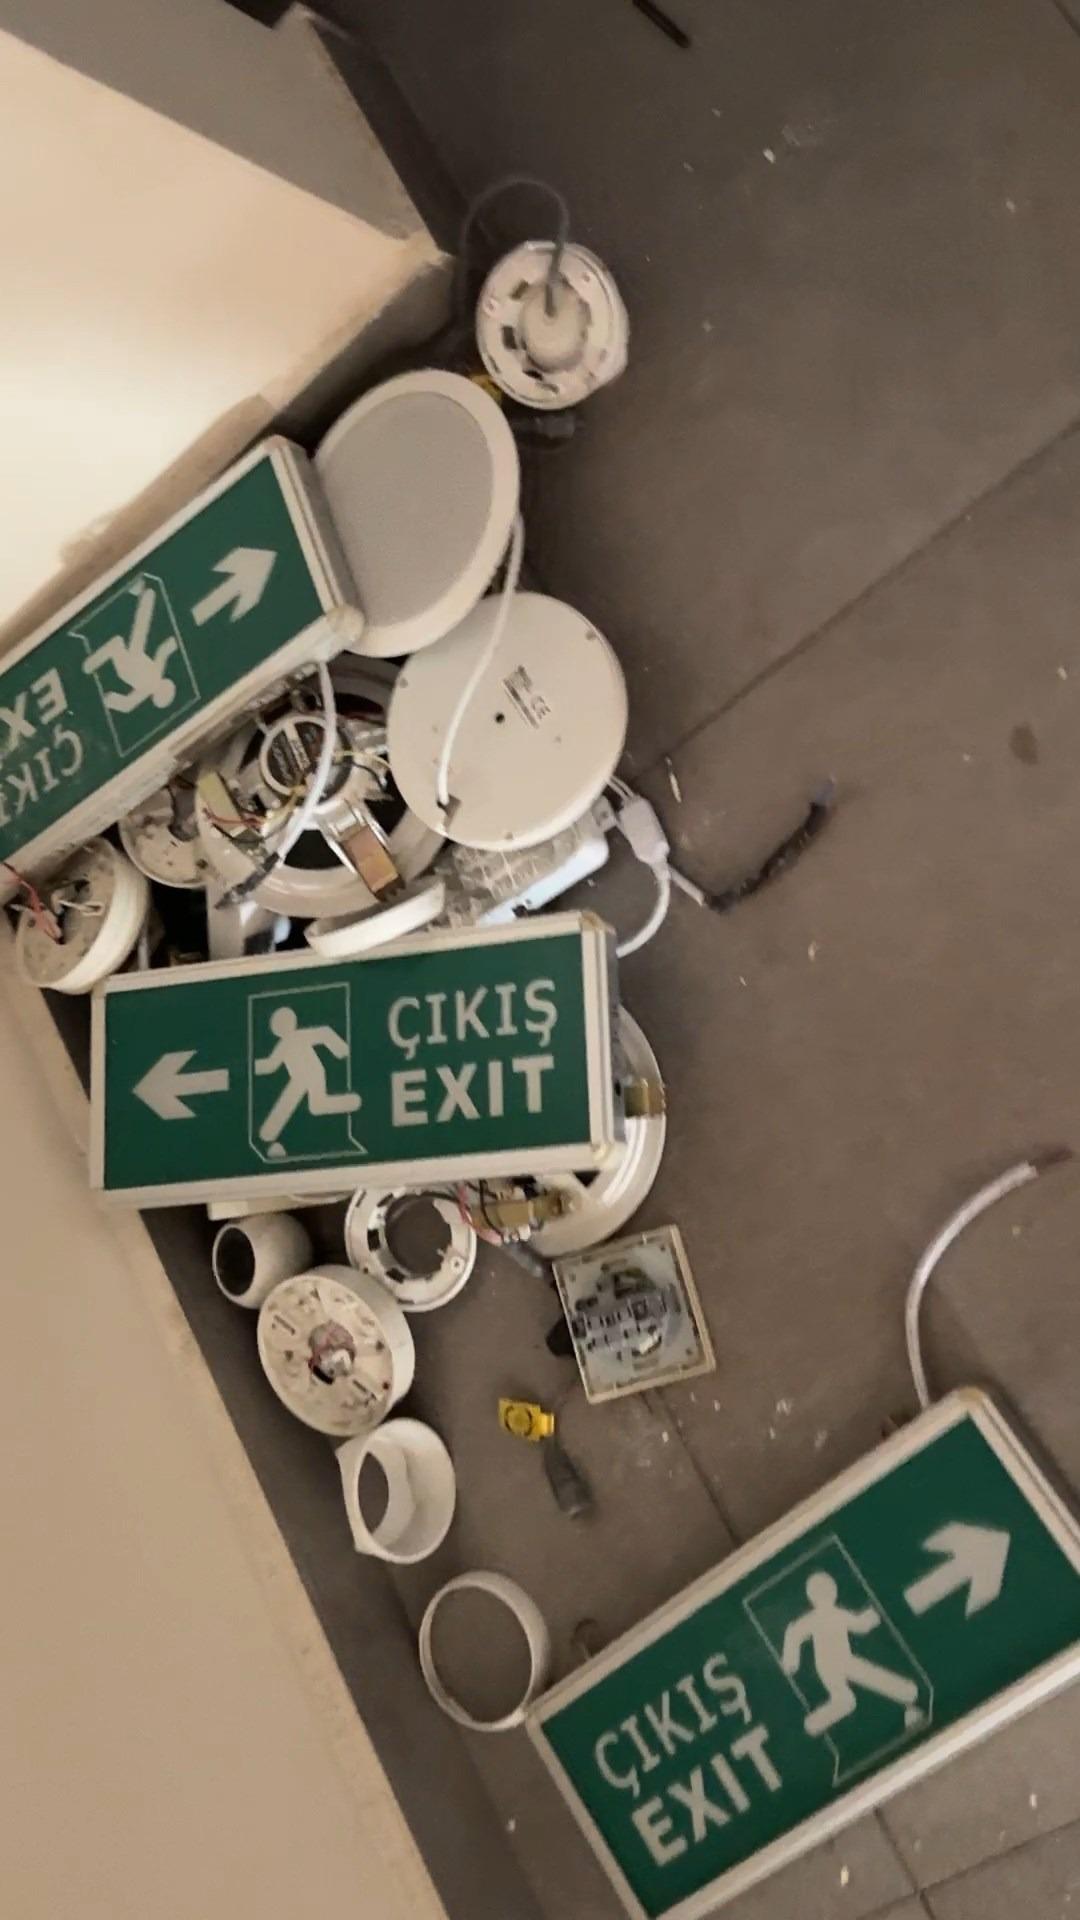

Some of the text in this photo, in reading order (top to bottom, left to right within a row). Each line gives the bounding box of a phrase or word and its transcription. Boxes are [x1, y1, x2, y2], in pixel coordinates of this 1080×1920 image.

[387, 979, 558, 1060] ÇIKIŞ
[391, 1053, 555, 1128] EXIT
[595, 1652, 752, 1797] ÇIKIŞ
[631, 1723, 782, 1868] EXIT
